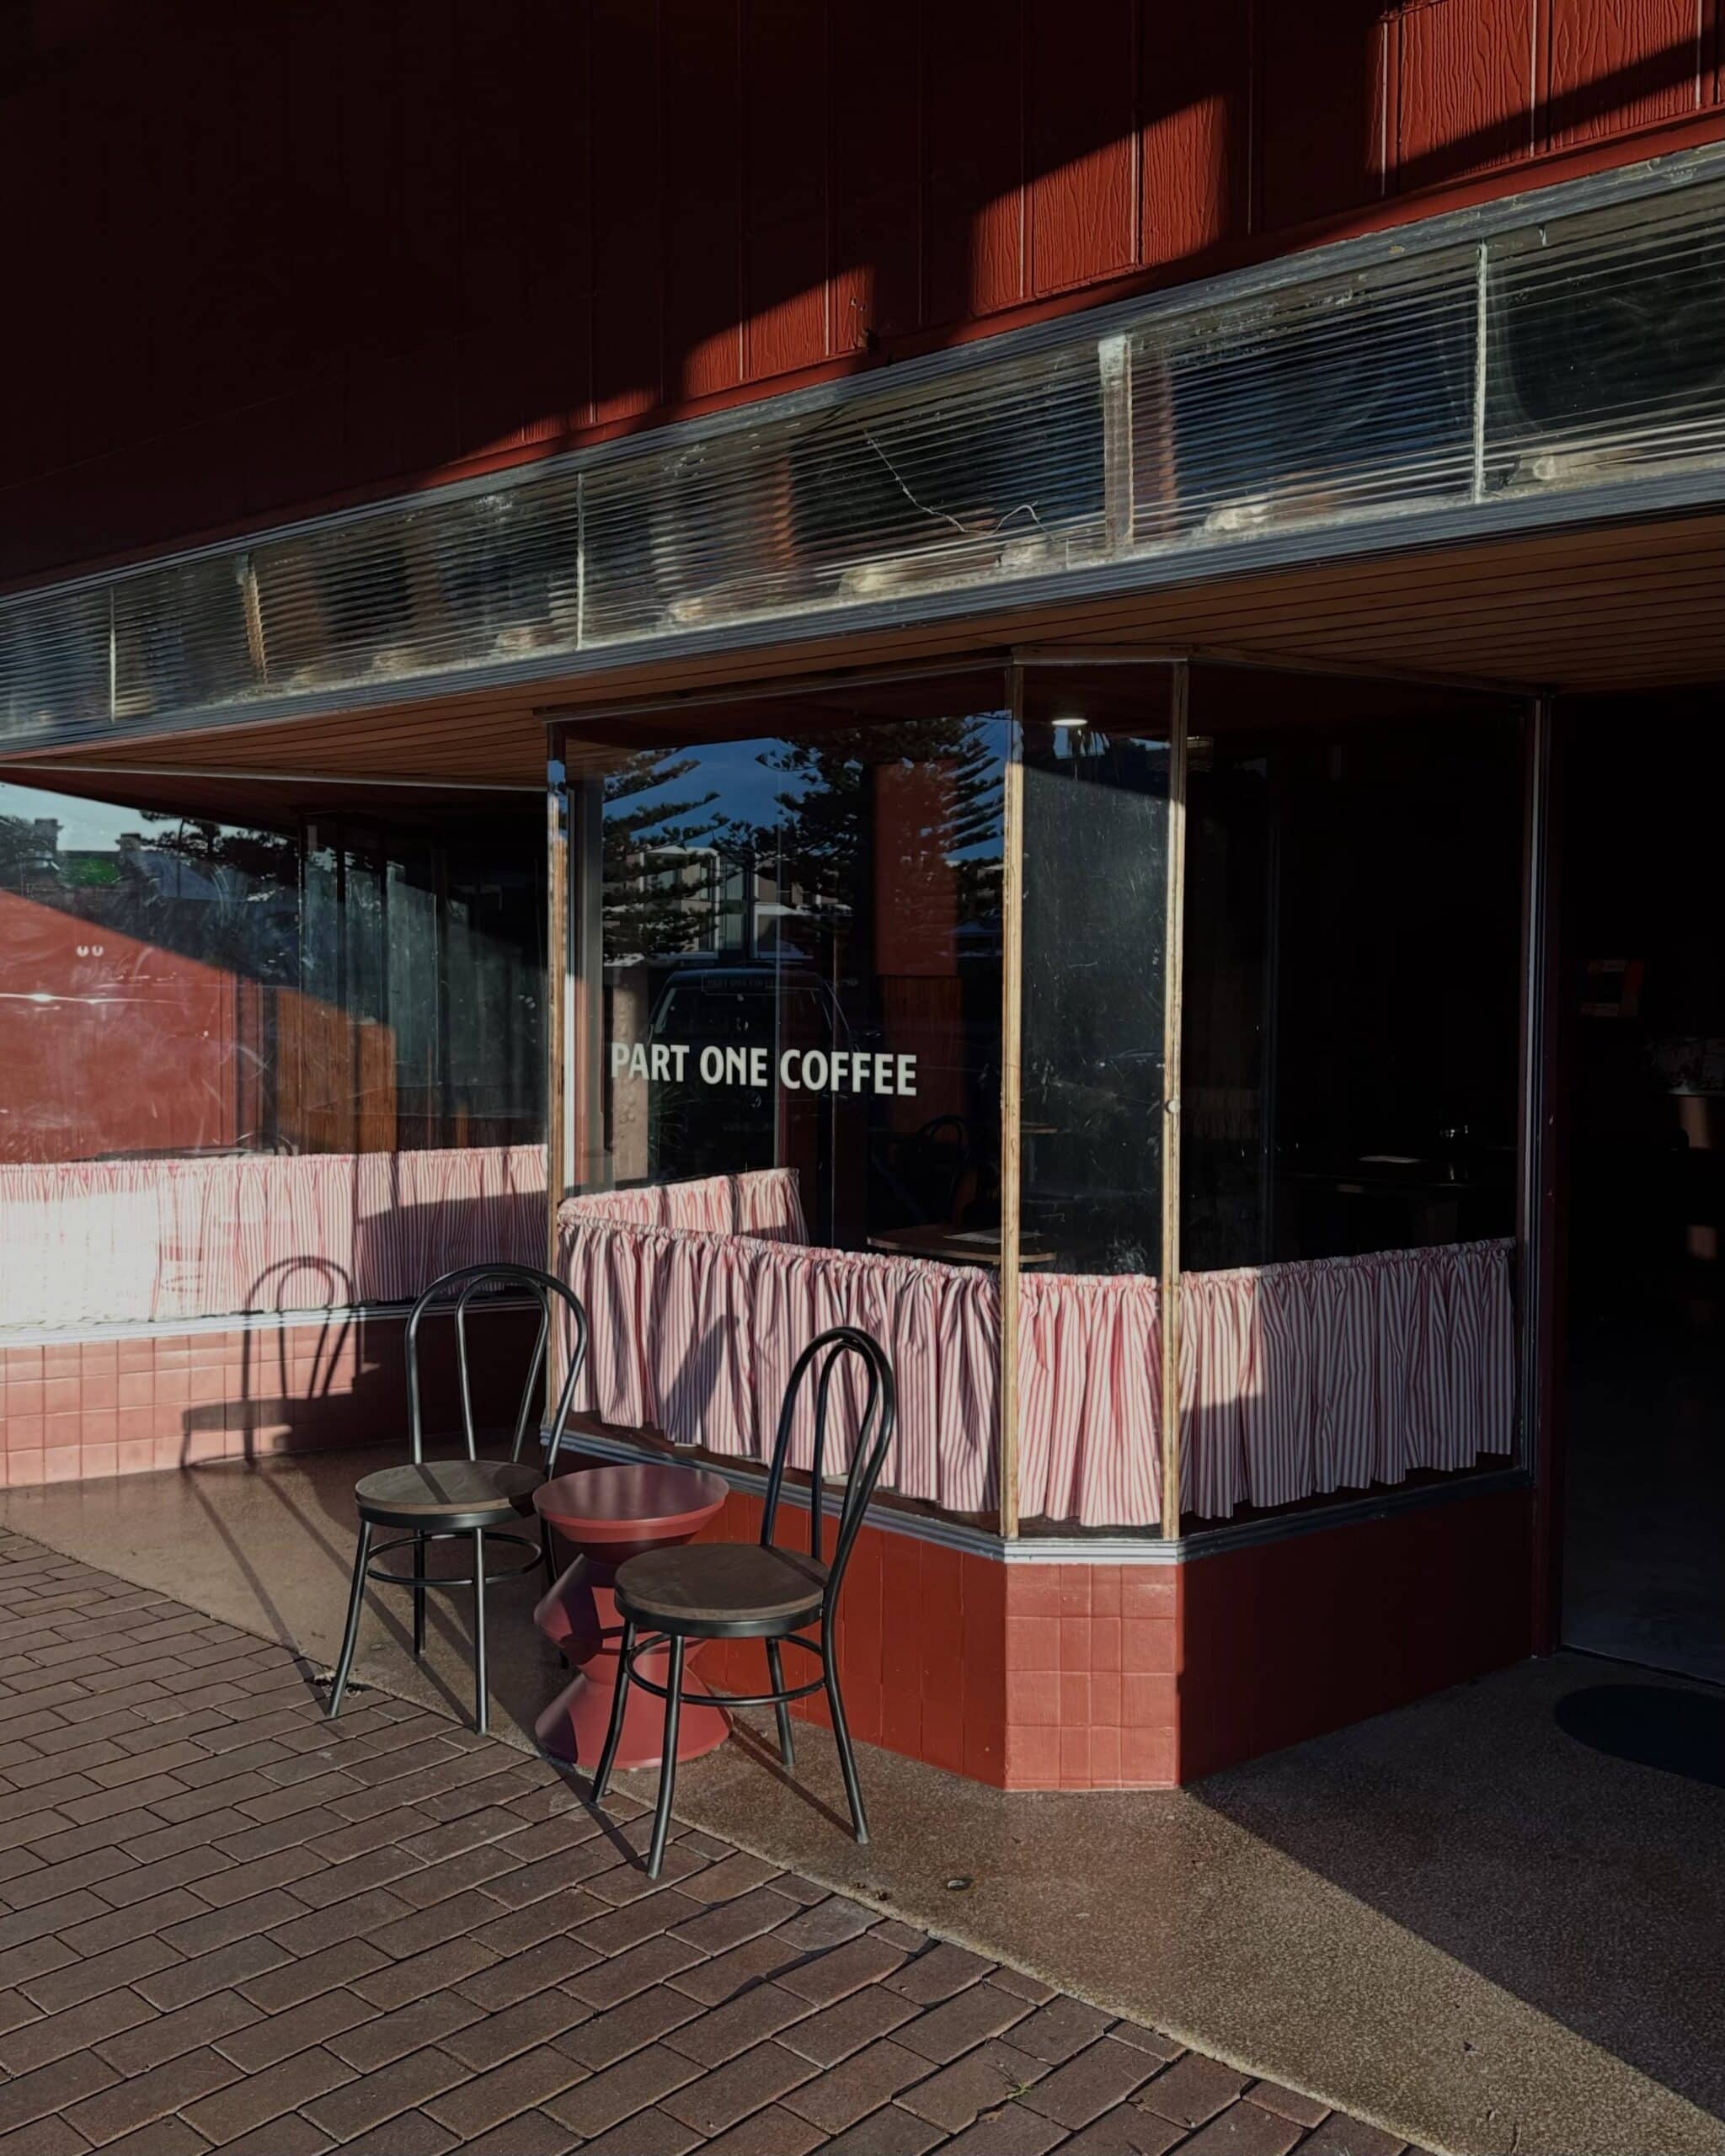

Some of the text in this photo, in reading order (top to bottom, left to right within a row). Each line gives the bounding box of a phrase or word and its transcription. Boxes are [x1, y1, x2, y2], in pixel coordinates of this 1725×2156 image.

[611, 1042, 917, 1096] PART ONE COFFEE
